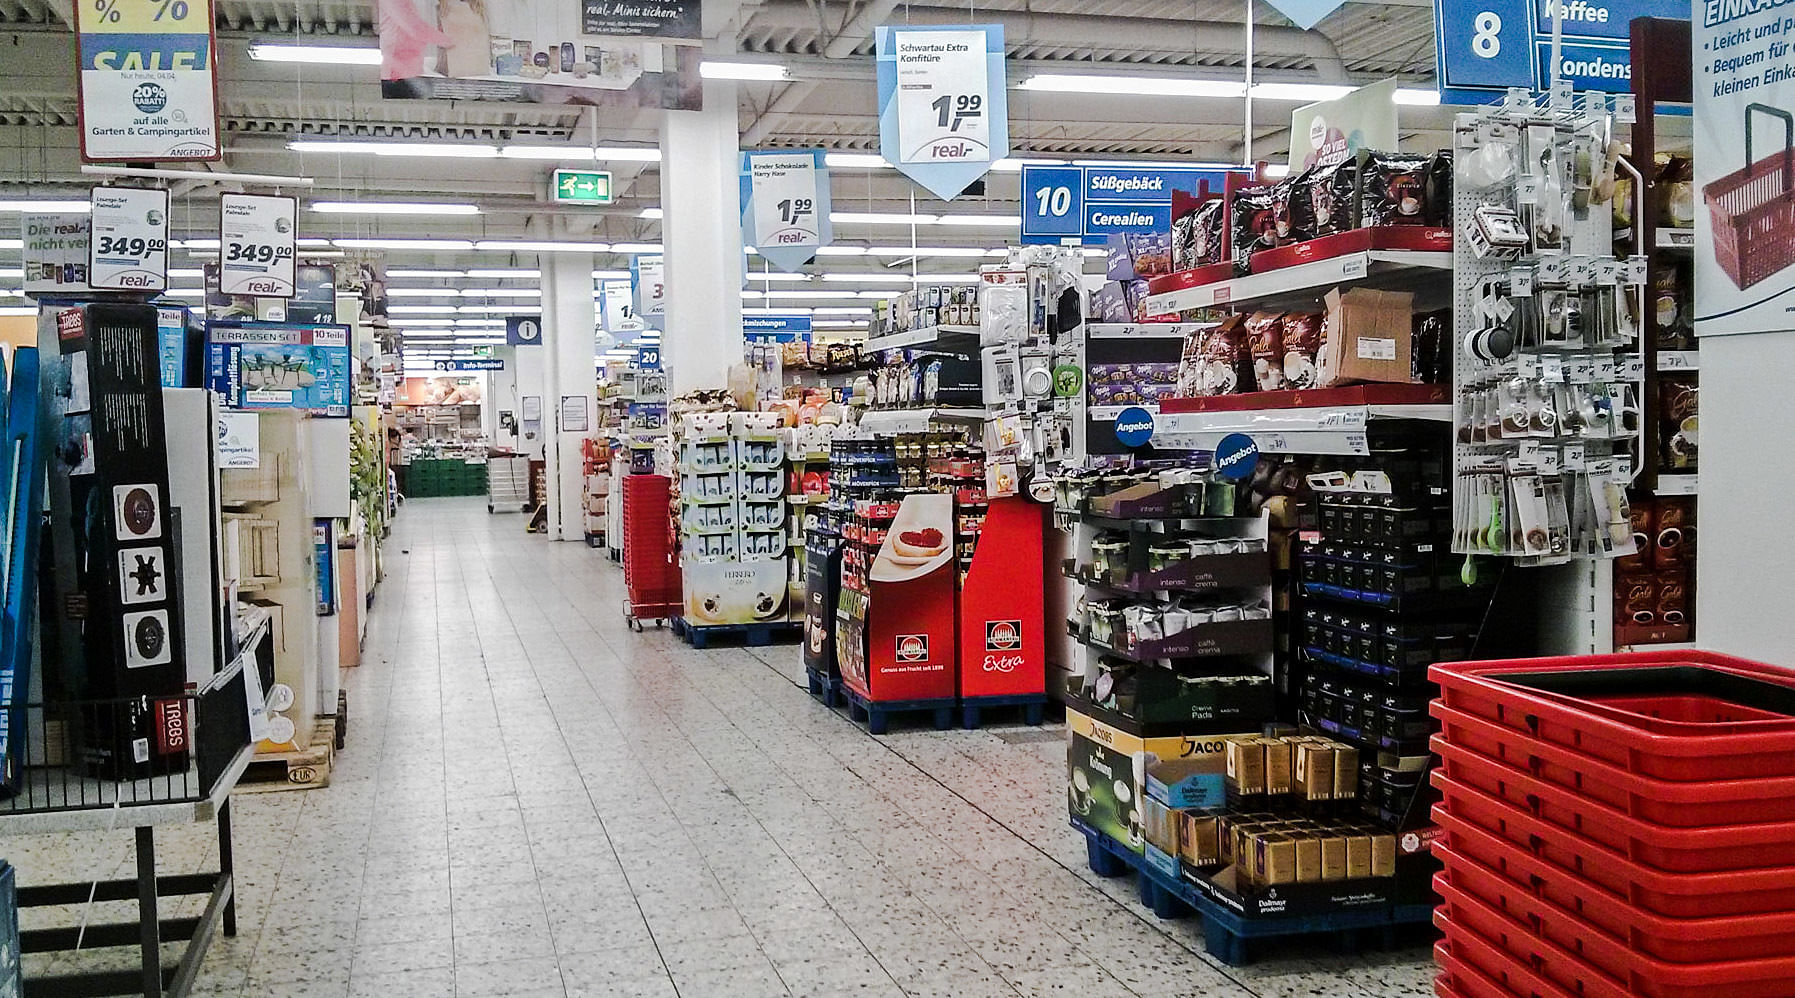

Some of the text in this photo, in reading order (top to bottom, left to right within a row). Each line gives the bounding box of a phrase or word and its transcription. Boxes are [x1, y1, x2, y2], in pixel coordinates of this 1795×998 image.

[612, 3, 641, 17] Minis
[1471, 11, 1502, 59] 8
[1713, 28, 1751, 51] Leicht
[1754, 17, 1781, 39] und
[899, 43, 968, 52] Schwartau Extra
[900, 54, 941, 63] Konfitüre
[1713, 41, 1789, 74] Bequem für
[1550, 56, 1632, 80] ondens
[134, 86, 166, 98] 20%
[1713, 75, 1759, 97] kleinen
[133, 116, 169, 125] auf alle
[92, 127, 210, 138] Garten & Campingartikel
[1090, 175, 1163, 192] Süßgebäck
[1035, 186, 1071, 217] 10
[777, 199, 813, 225] 1,99
[1091, 211, 1154, 226] Cerealien
[28, 224, 51, 236] Die
[29, 238, 63, 251] nicht
[216, 332, 278, 341] TERRASSEN
[314, 330, 345, 340] 10 Teile
[641, 352, 658, 364] 20
[463, 361, 503, 369] Info-Terminal
[1116, 421, 1153, 434] Angebot
[1218, 443, 1258, 469] Angebot
[1160, 578, 1186, 586] intenso
[1194, 580, 1218, 588] crema
[983, 654, 1025, 672] Extra
[1191, 711, 1213, 720] Pads
[293, 770, 312, 780] EUR
